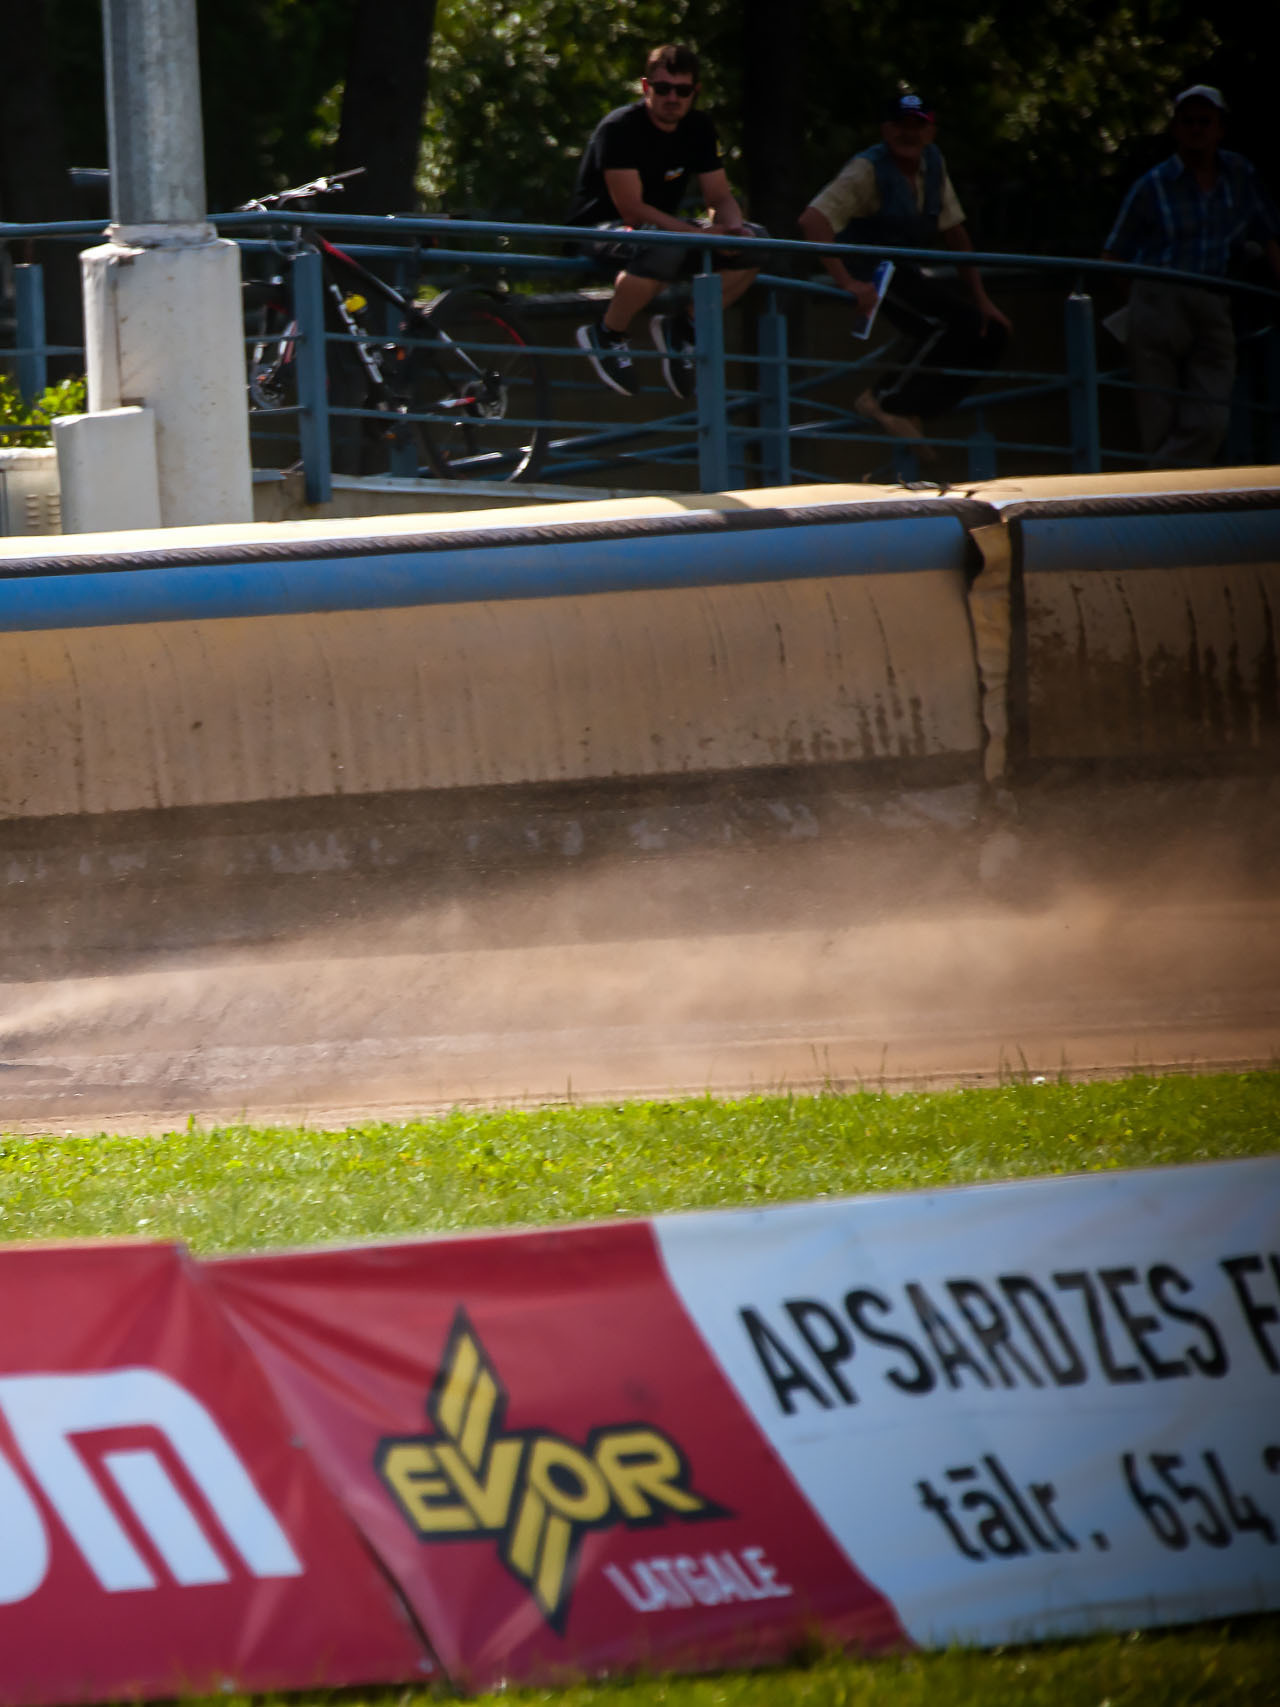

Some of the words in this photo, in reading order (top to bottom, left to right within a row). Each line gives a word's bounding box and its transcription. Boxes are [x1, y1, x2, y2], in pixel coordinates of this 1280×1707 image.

[737, 1262, 1231, 1417] APSARDZES
[1122, 1445, 1280, 1551] 654
[605, 1546, 794, 1613] LATGALE
